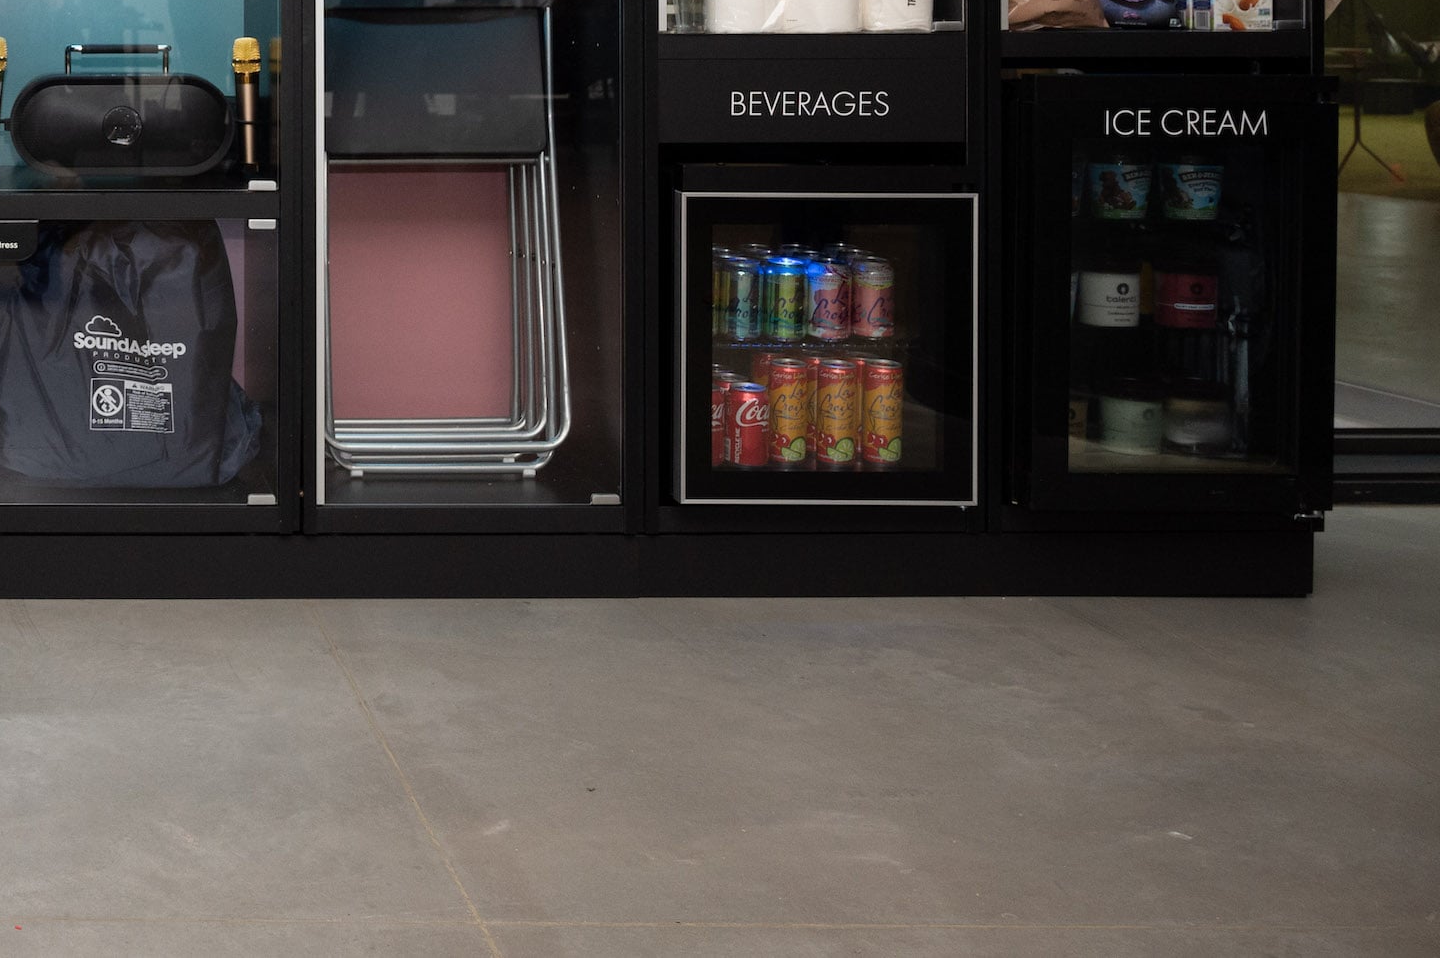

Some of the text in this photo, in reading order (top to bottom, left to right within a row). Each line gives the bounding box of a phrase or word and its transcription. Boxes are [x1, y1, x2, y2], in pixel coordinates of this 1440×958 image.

[730, 91, 890, 117] BEVERAGES
[1105, 109, 1268, 136] ICE CREAM
[74, 332, 187, 359] SoundAsleep
[92, 350, 168, 366] PRODUCTS
